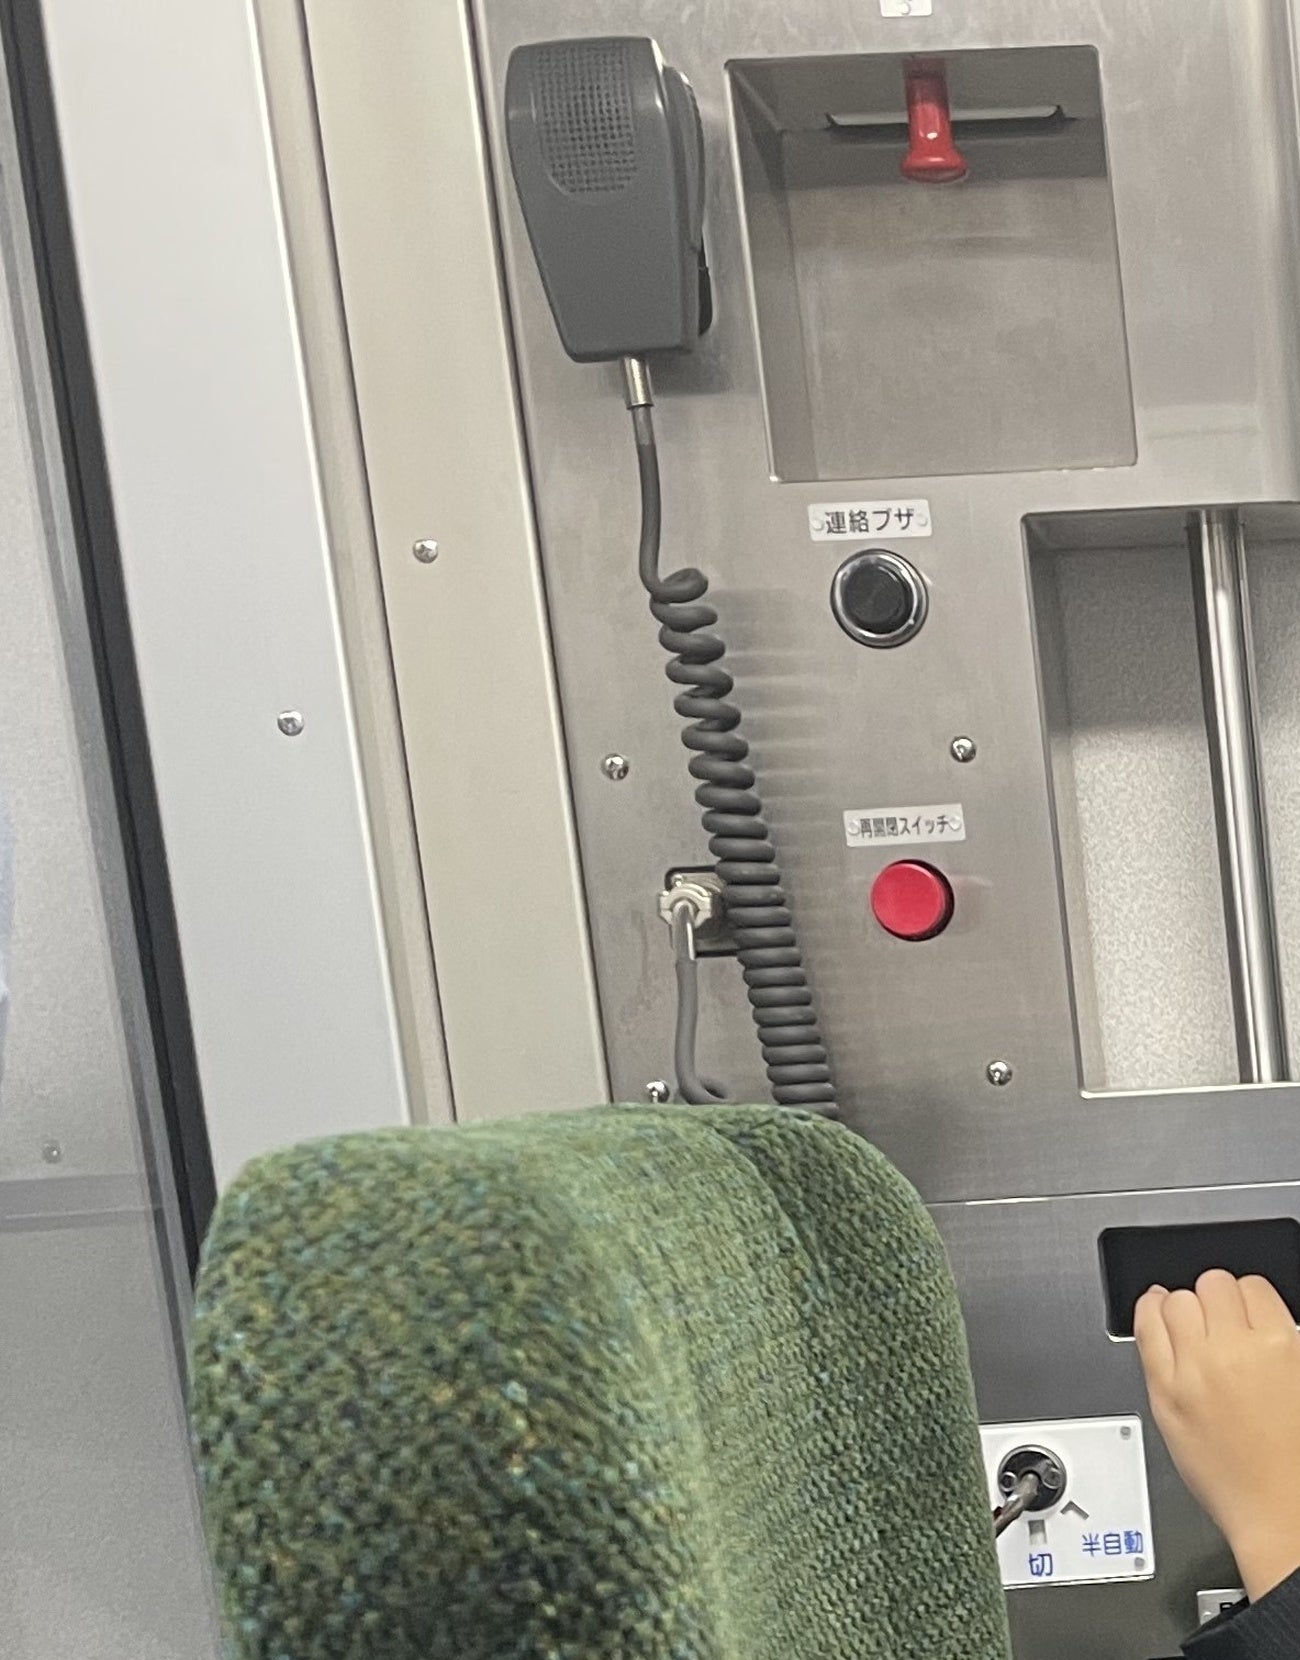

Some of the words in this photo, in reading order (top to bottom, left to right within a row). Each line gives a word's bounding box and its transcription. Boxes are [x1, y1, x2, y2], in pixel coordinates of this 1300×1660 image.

[1081, 1530, 1144, 1557] 半自動
[1028, 1552, 1053, 1577] 切
